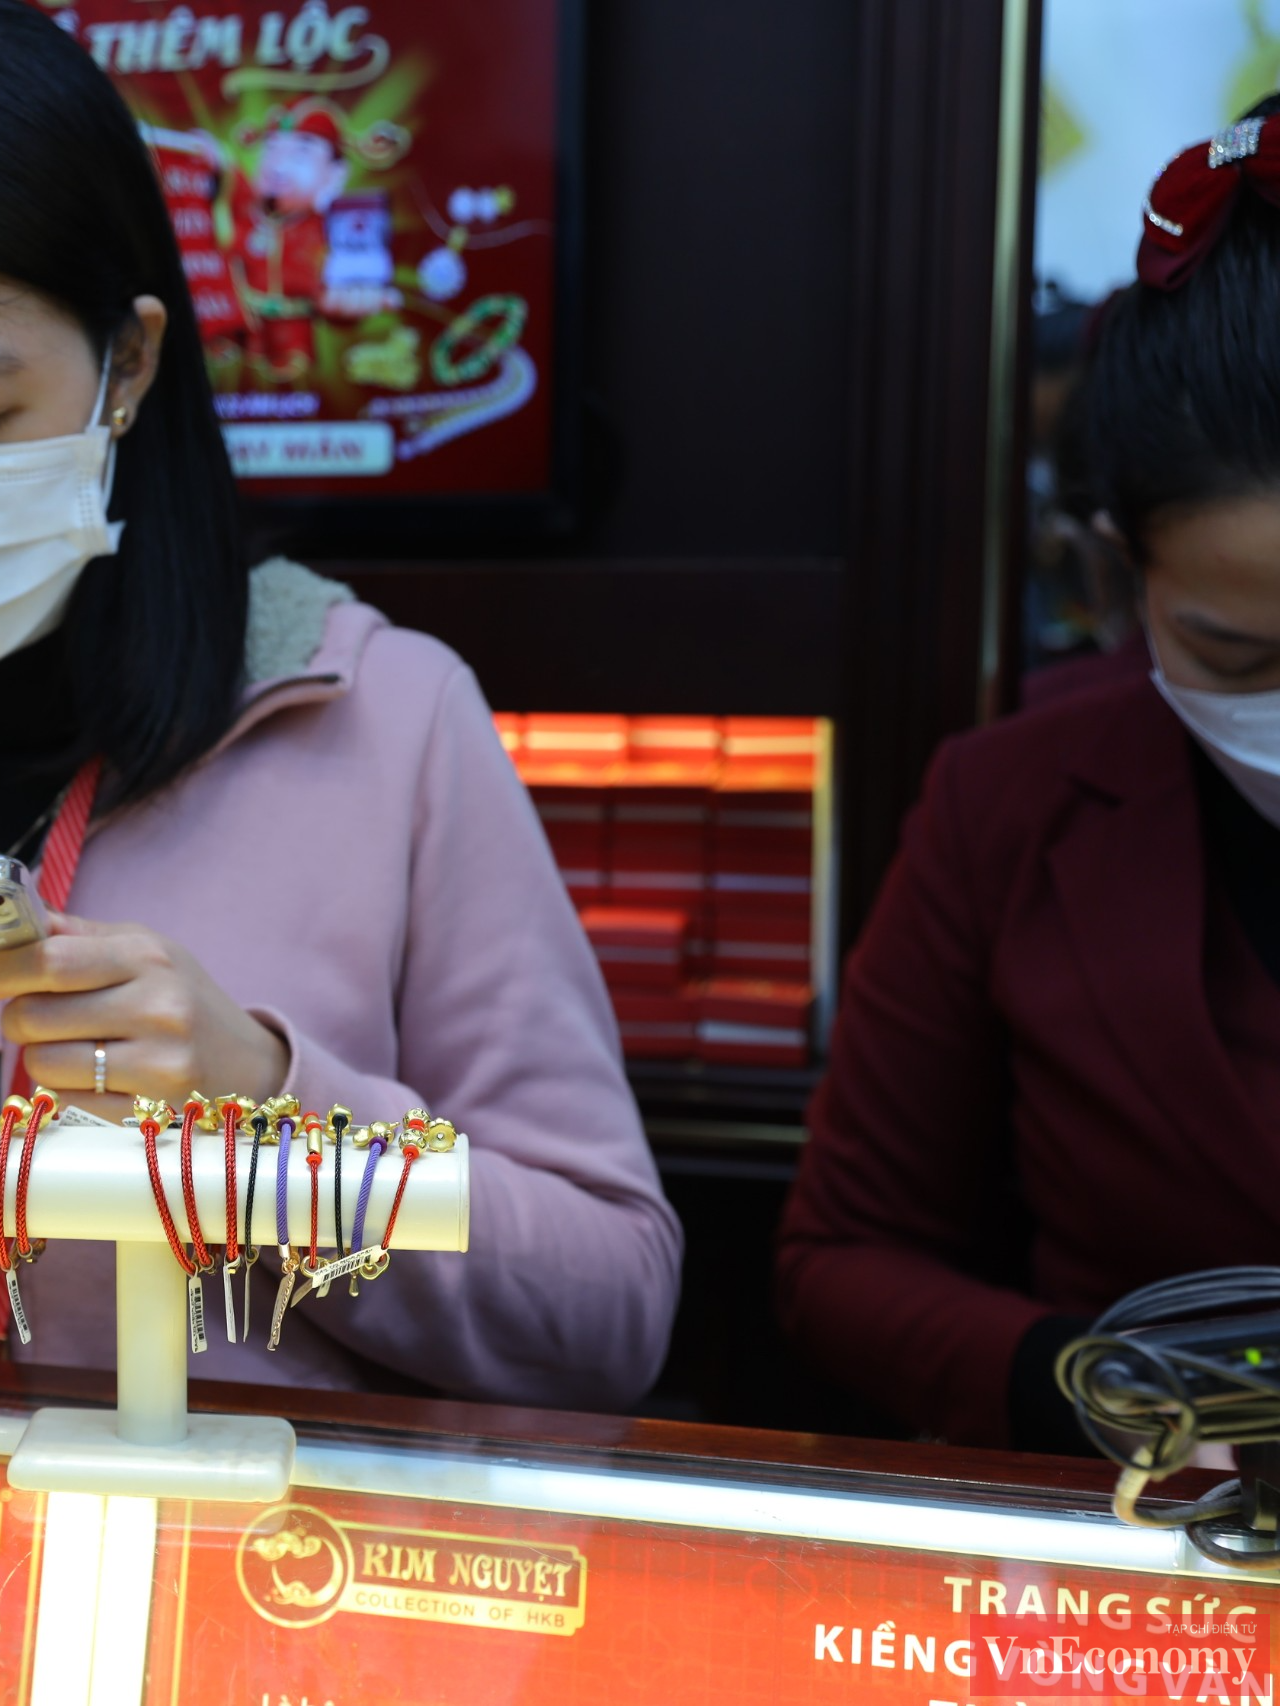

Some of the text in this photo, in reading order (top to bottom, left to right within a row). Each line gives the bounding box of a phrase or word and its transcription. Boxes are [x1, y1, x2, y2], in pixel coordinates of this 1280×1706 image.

[84, 0, 369, 74] THÊM LỘC
[361, 1541, 573, 1603] KIM NGUYỆT
[354, 1592, 566, 1629] COLLECTION OF HKB
[943, 1575, 1258, 1645] TRANG SỨC
[814, 1619, 977, 1678] KIỀNG
